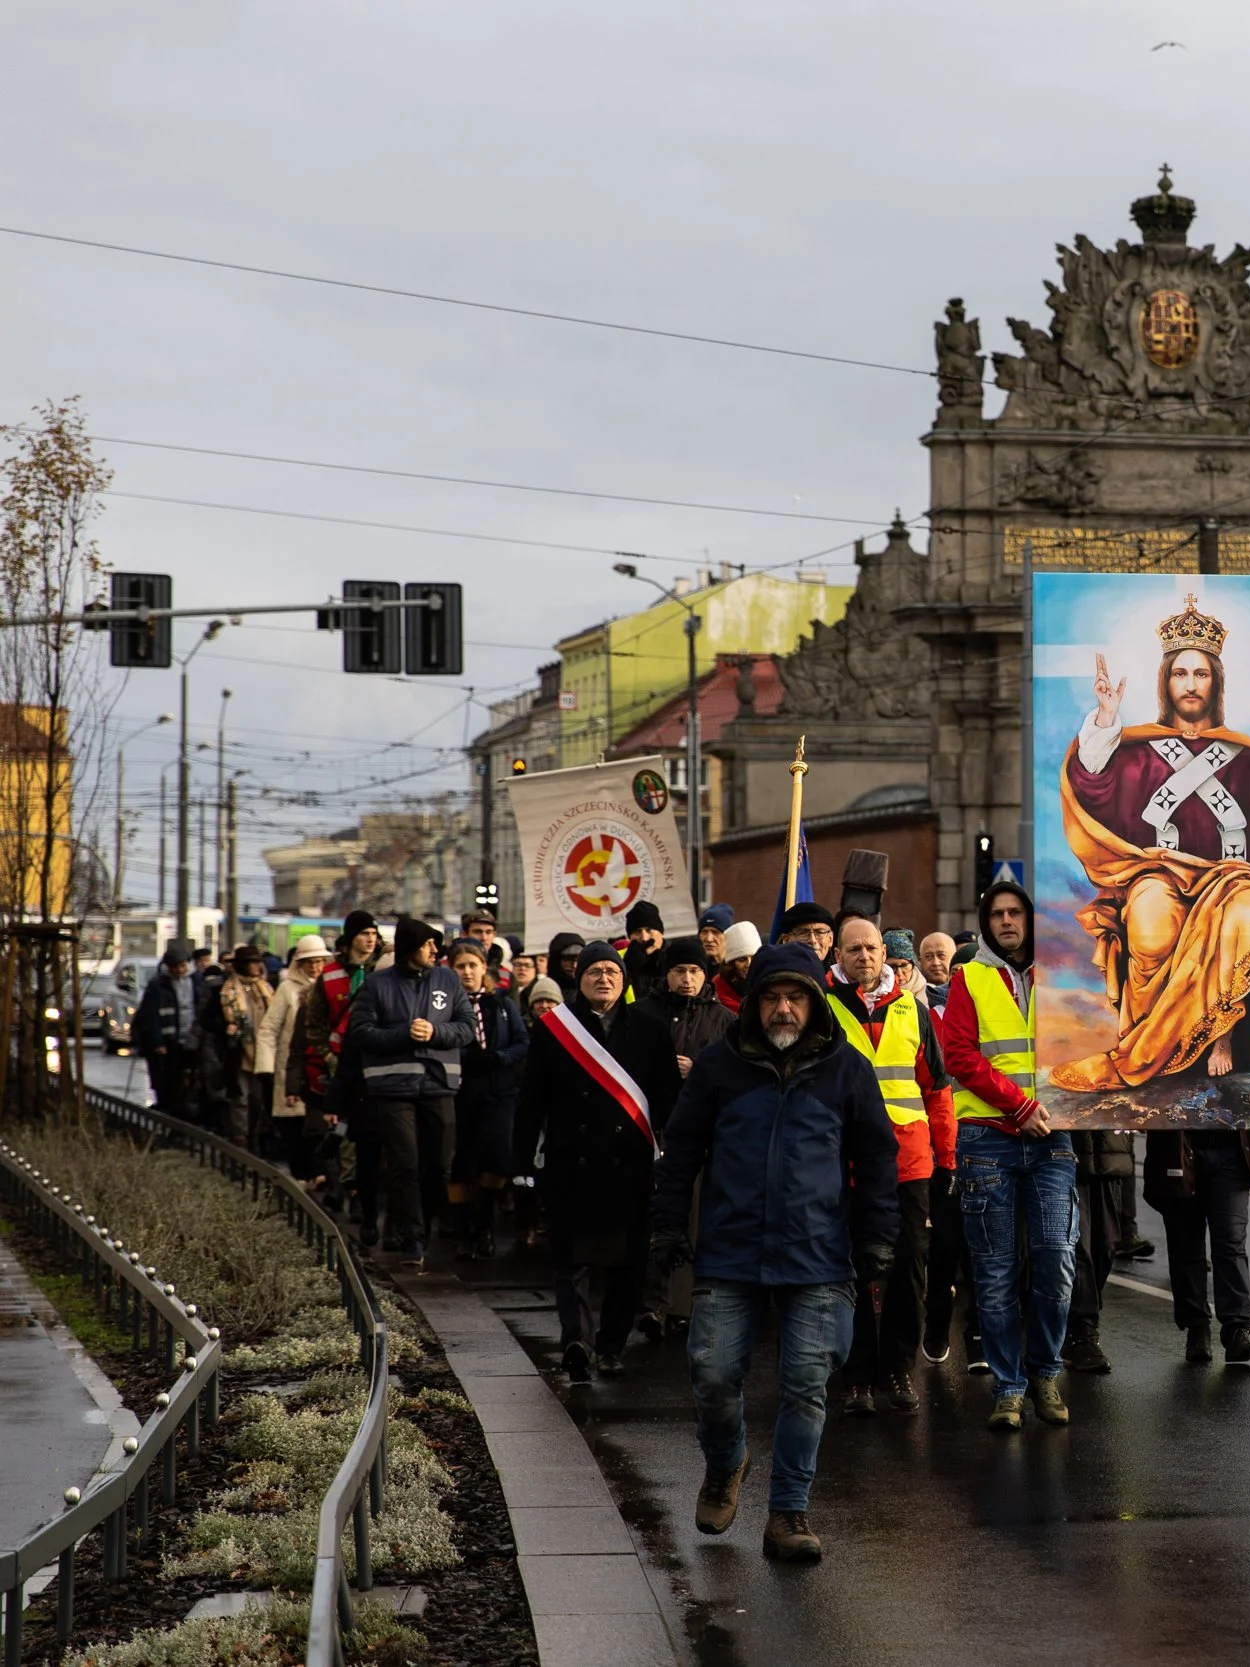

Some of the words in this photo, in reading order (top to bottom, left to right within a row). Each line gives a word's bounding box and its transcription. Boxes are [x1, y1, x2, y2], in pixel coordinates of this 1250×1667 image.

[562, 823, 598, 853] ODNOWA
[599, 824, 608, 832] W
[610, 825, 643, 852] DUCHU
[532, 818, 565, 908] ARCHIDIECEZJA
[555, 855, 572, 912] KATOLICKA
